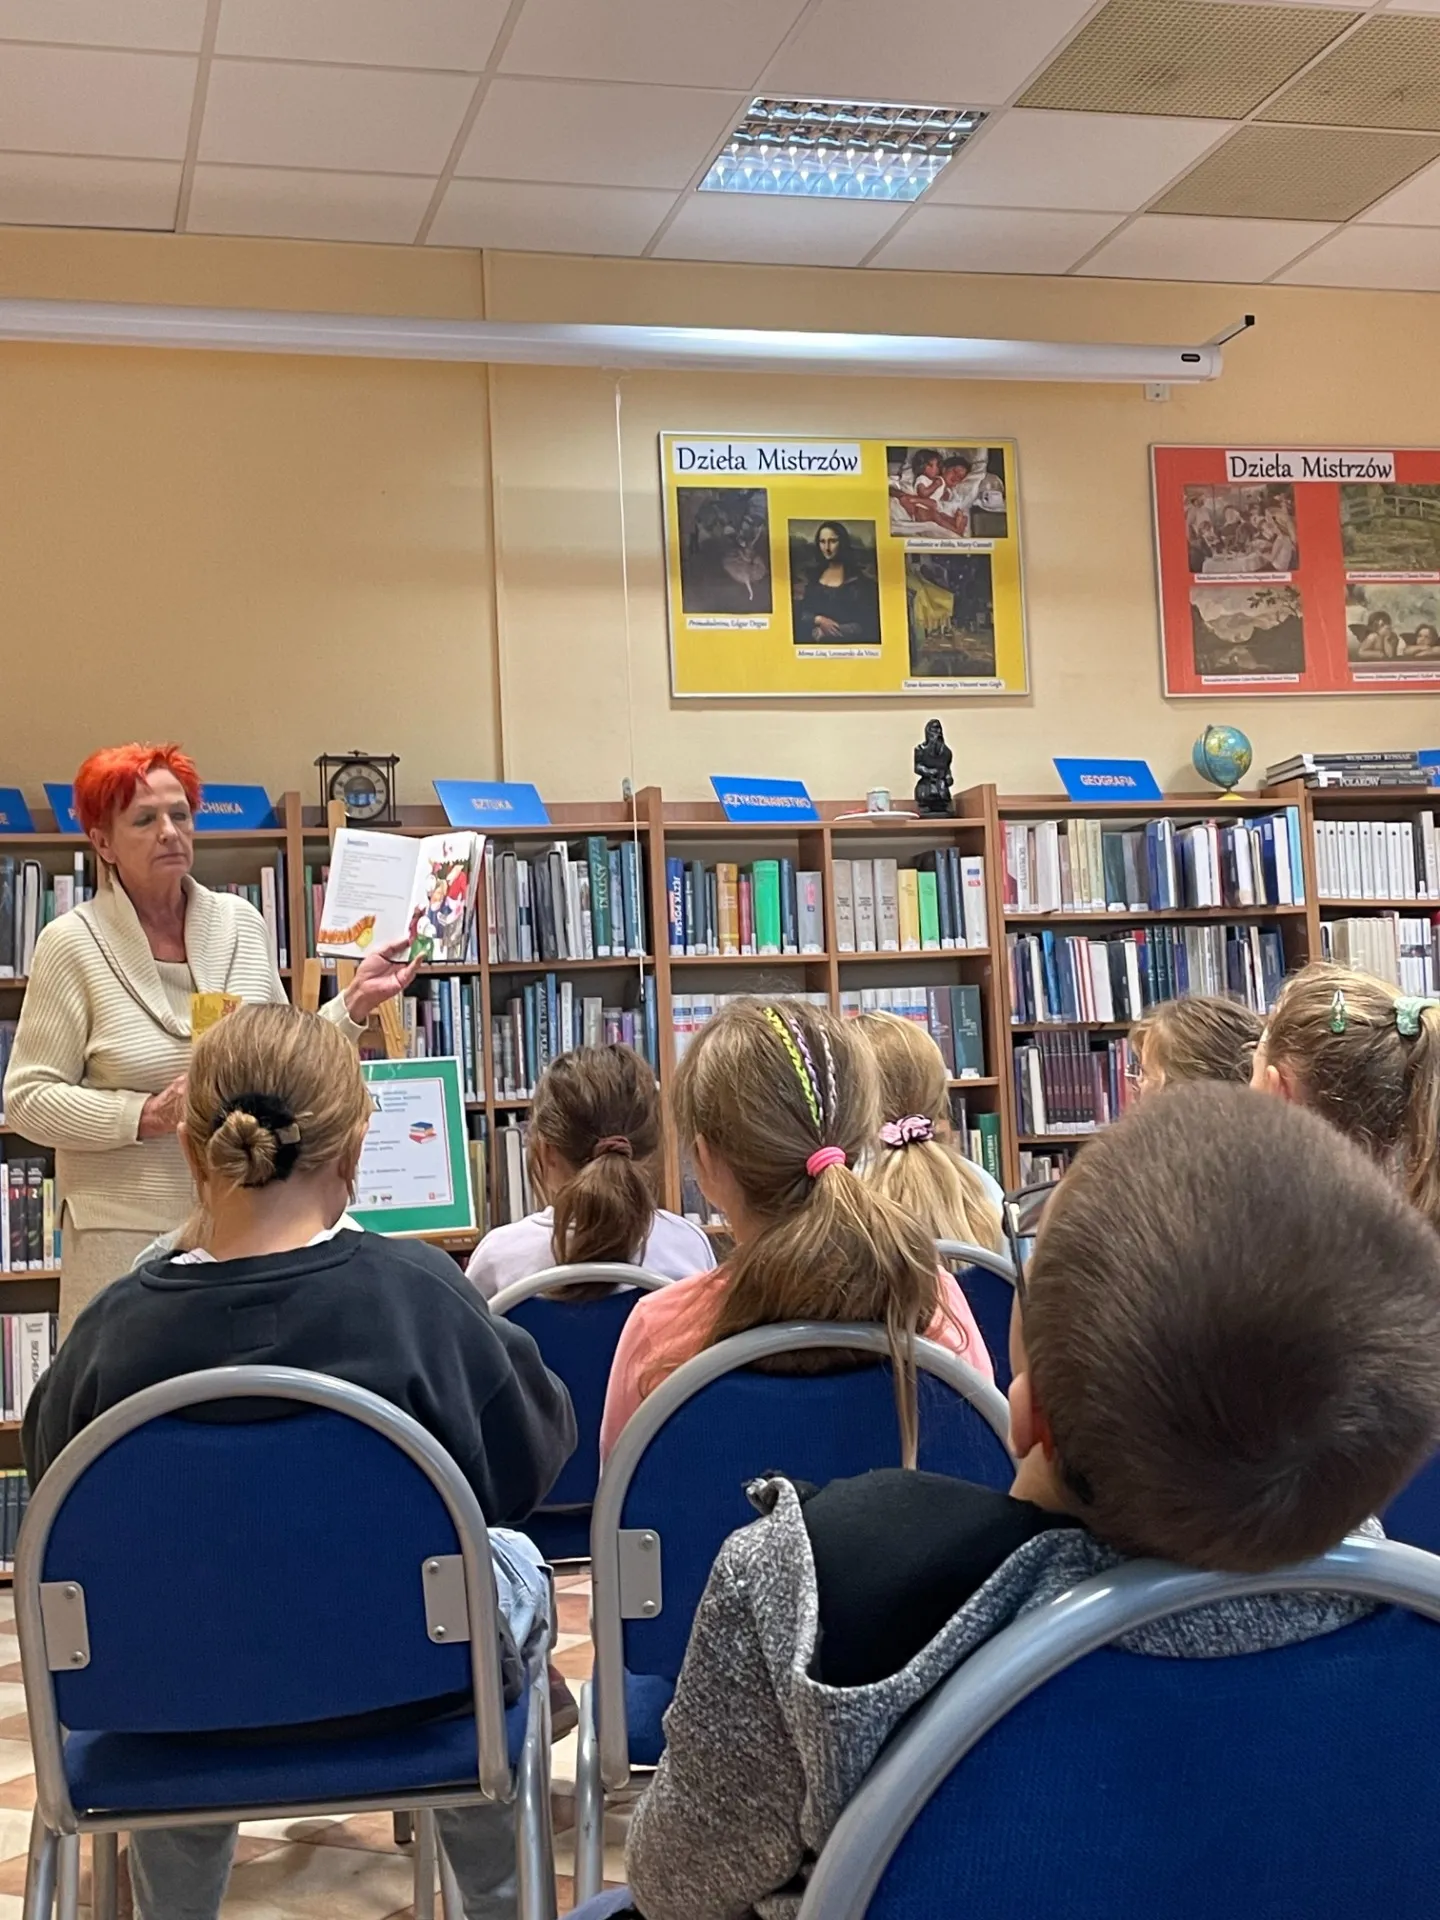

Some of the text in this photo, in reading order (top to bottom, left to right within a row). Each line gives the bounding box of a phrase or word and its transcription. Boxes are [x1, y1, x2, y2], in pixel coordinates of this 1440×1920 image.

[677, 445, 859, 472] Dzieła Mistrzów
[1230, 453, 1393, 479] Dzieła Mistrzów
[1080, 774, 1137, 787] GEOGRAFIA
[200, 801, 244, 815] CHNIKA
[471, 798, 513, 810] SZTUKA
[723, 793, 811, 809] JĘZYKOZNAWSTWO
[674, 904, 683, 936] POLSKI
